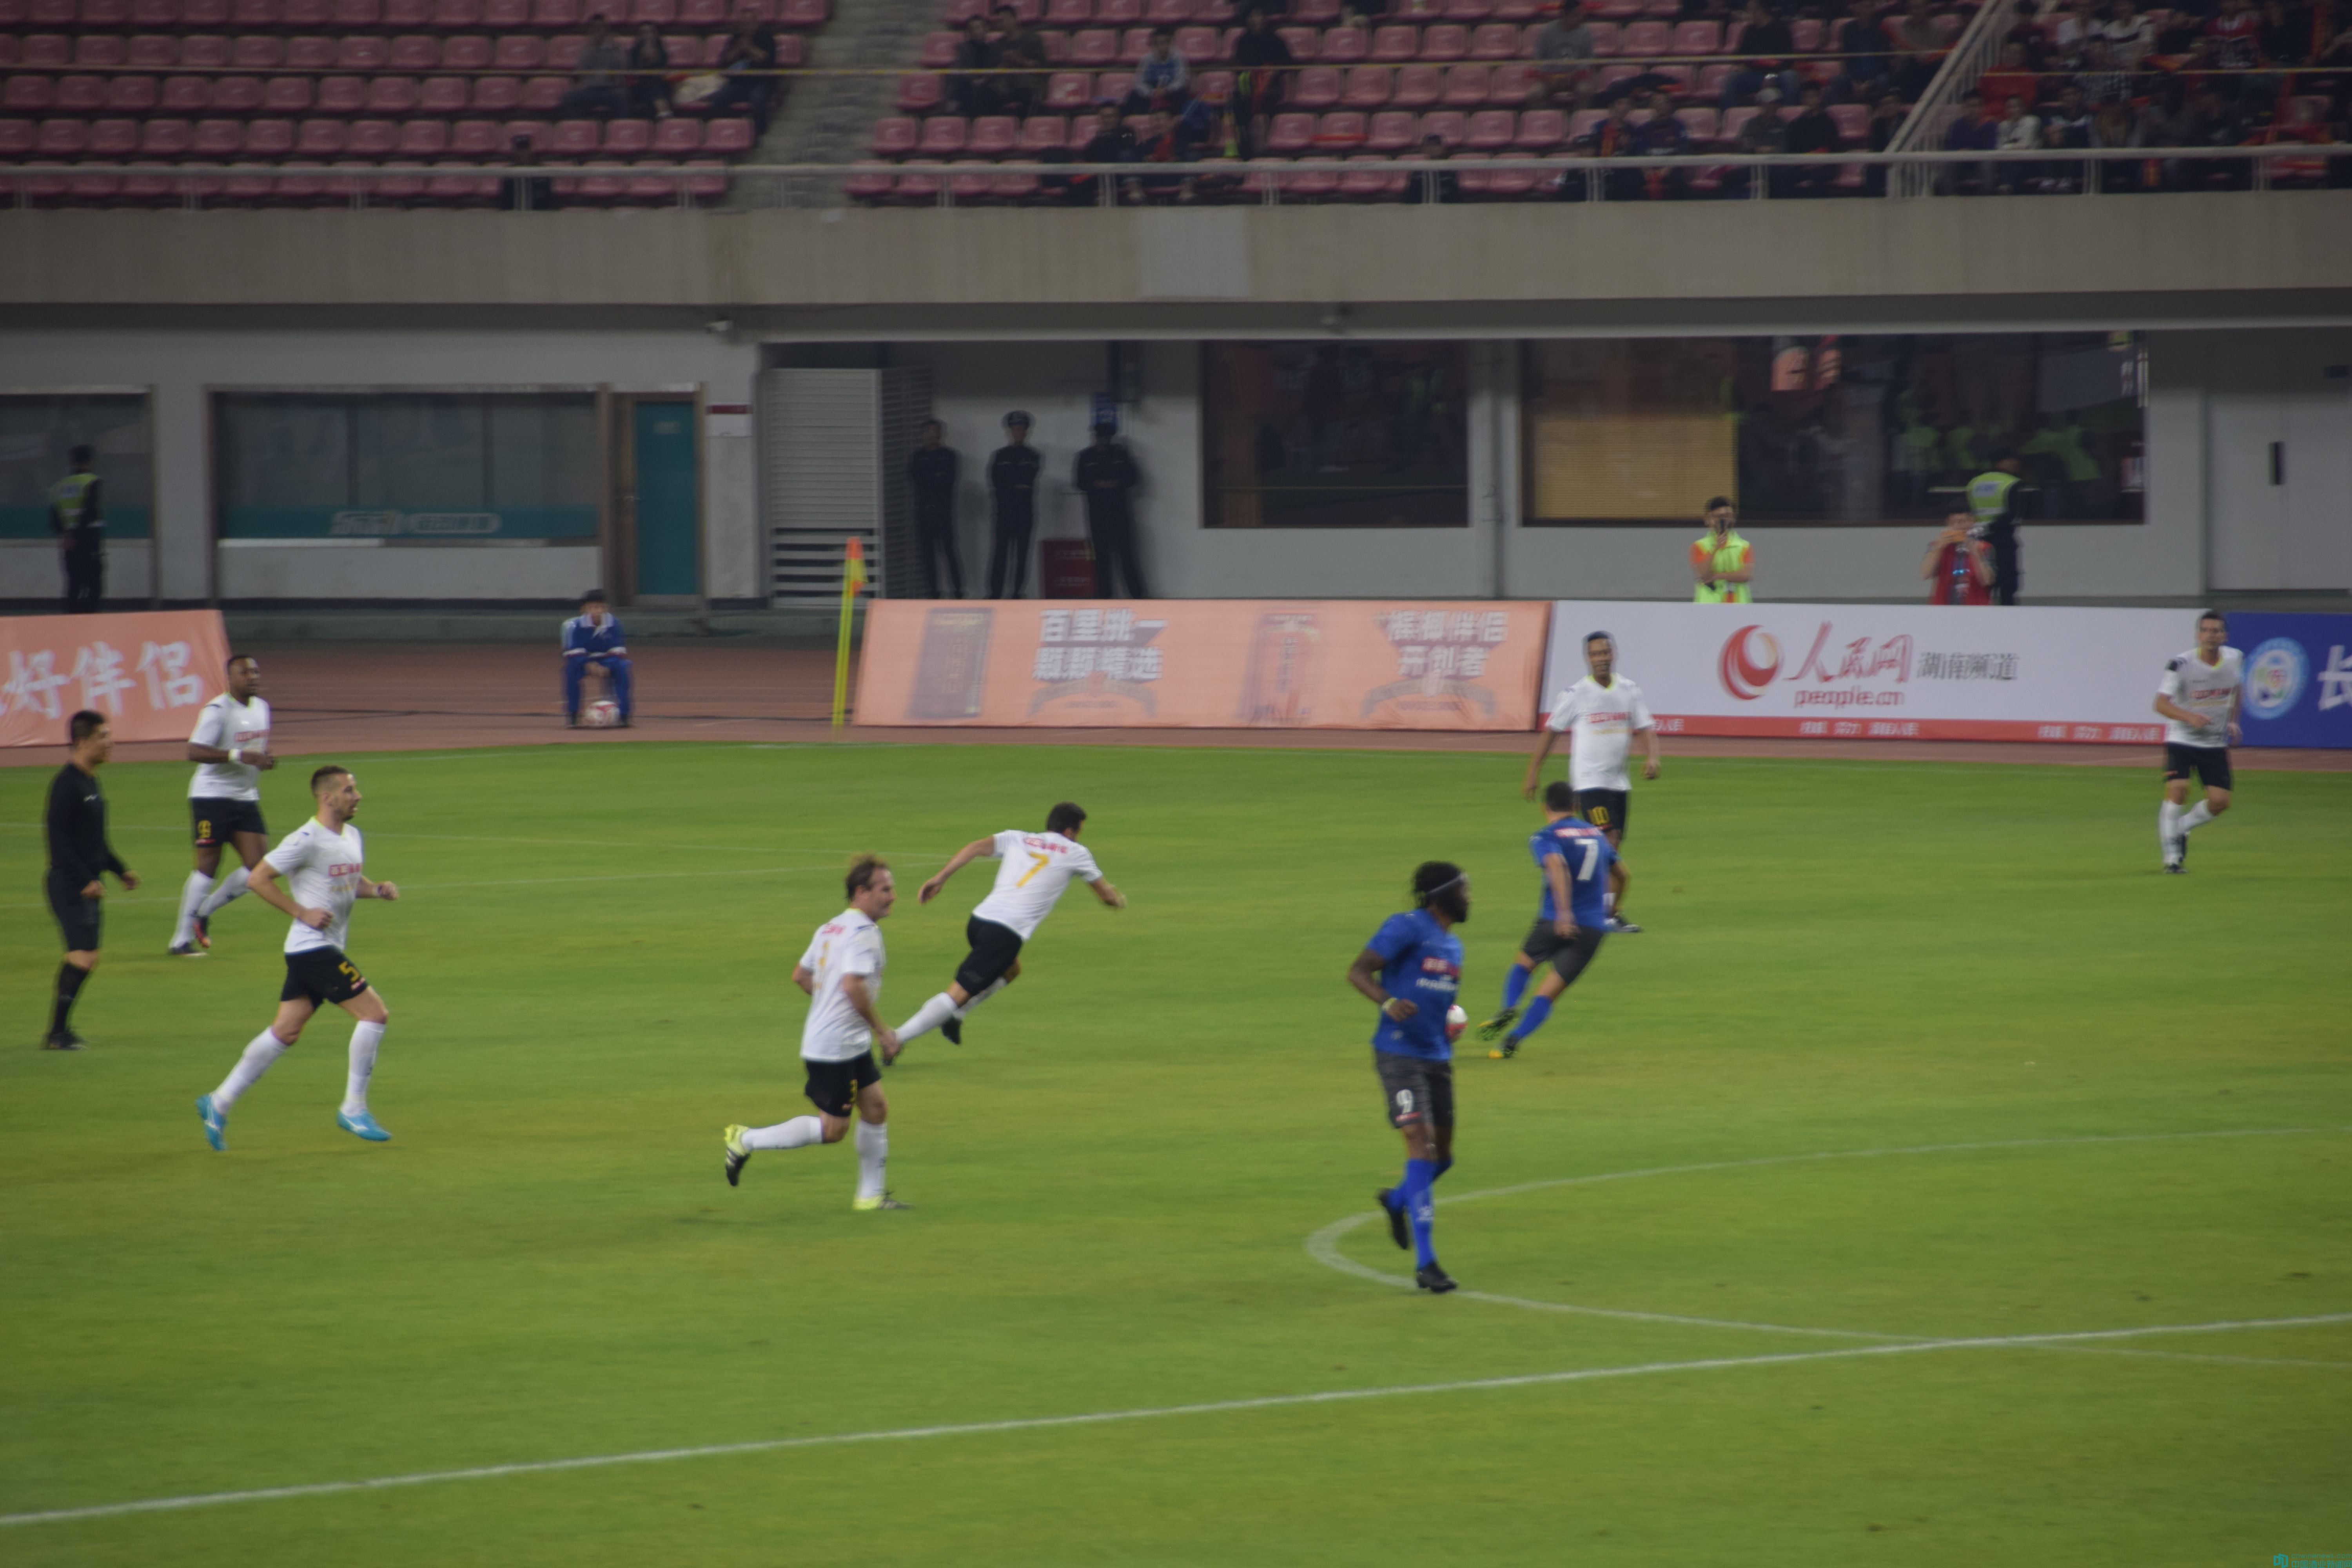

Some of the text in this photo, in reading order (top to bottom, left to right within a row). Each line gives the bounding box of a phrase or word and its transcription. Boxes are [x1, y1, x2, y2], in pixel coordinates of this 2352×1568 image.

[1040, 608, 1168, 642] 百里挑一
[1783, 621, 1913, 683] 人民网
[0, 641, 203, 719] 好伴侣
[1794, 686, 1905, 709] people.cn
[1016, 851, 1049, 888] 7
[1574, 838, 1599, 881] 7
[339, 961, 359, 983] 5
[1396, 1089, 1414, 1114] 9
